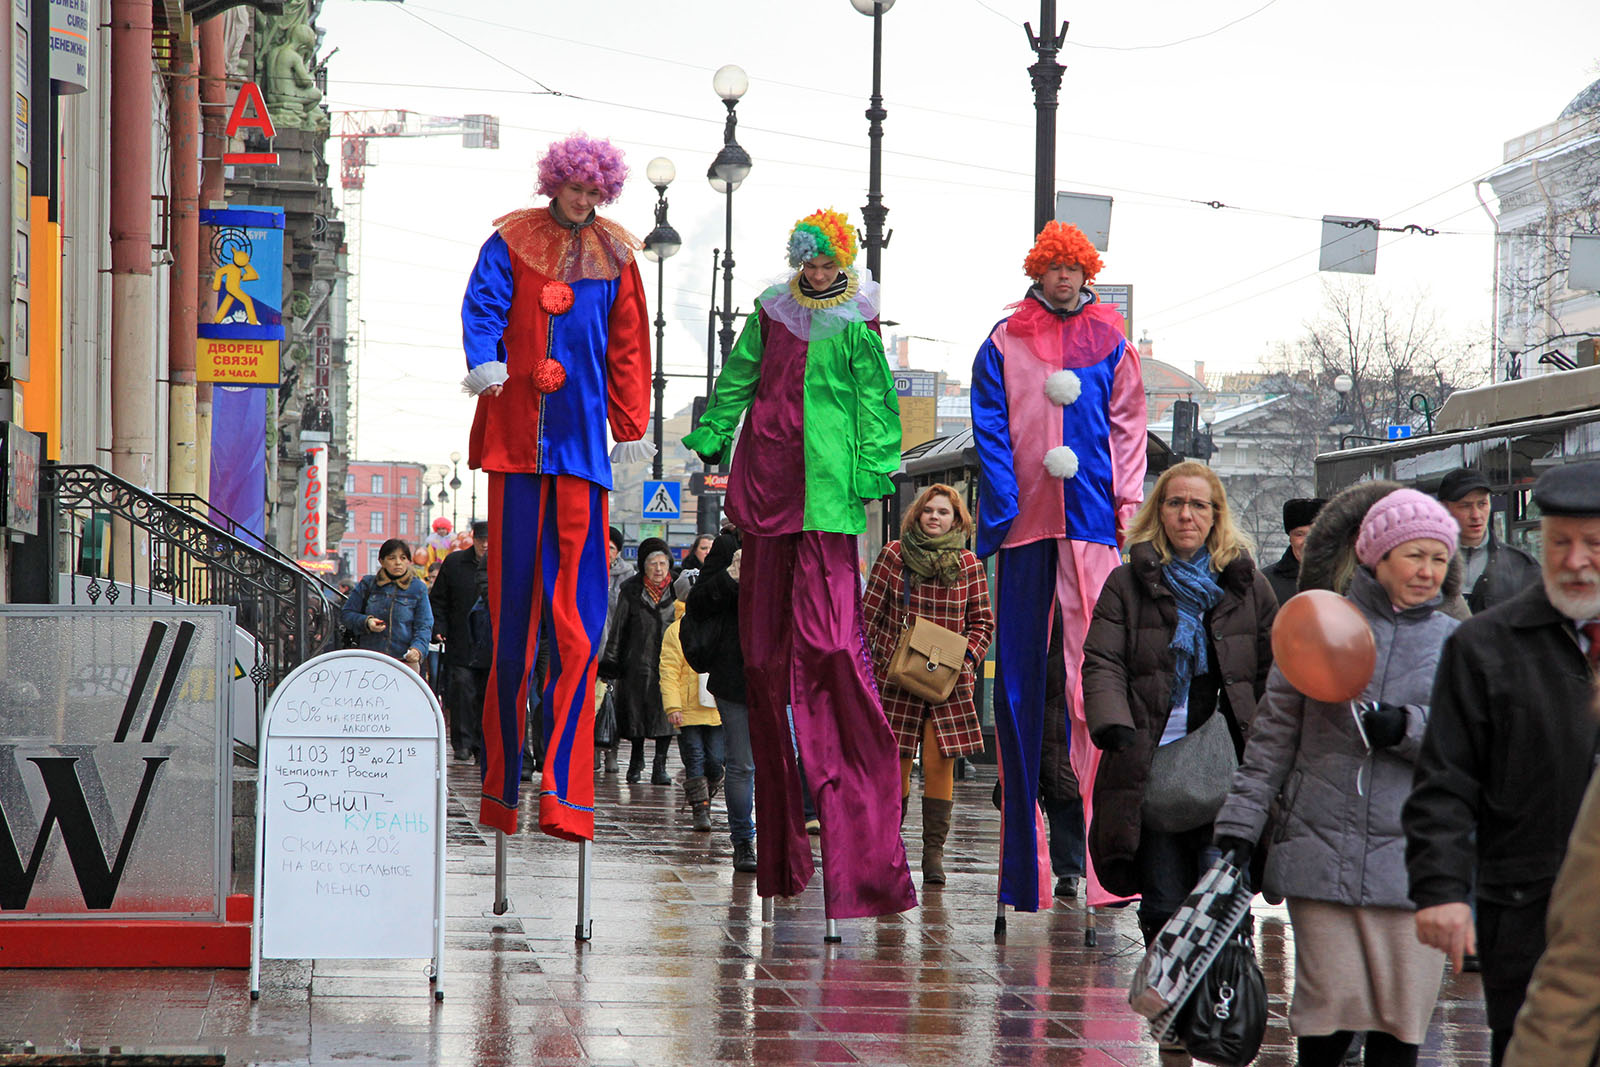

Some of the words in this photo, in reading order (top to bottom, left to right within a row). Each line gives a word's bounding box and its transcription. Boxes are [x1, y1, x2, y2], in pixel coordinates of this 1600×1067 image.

[208, 343, 264, 356] ДВОРЕЦ
[213, 356, 258, 366] СВЯЗИ
[213, 369, 226, 377] 24
[309, 669, 399, 693] ФУТБОЛ
[286, 700, 321, 723] 50%
[342, 724, 391, 733] АЛКОГОЛЬ
[344, 812, 429, 833] КУБАНЬ
[366, 835, 400, 855] 20%
[282, 859, 303, 872] НА
[340, 862, 413, 877] ОСТАЛЬНОЕ
[316, 880, 370, 897] МЕНЮ
